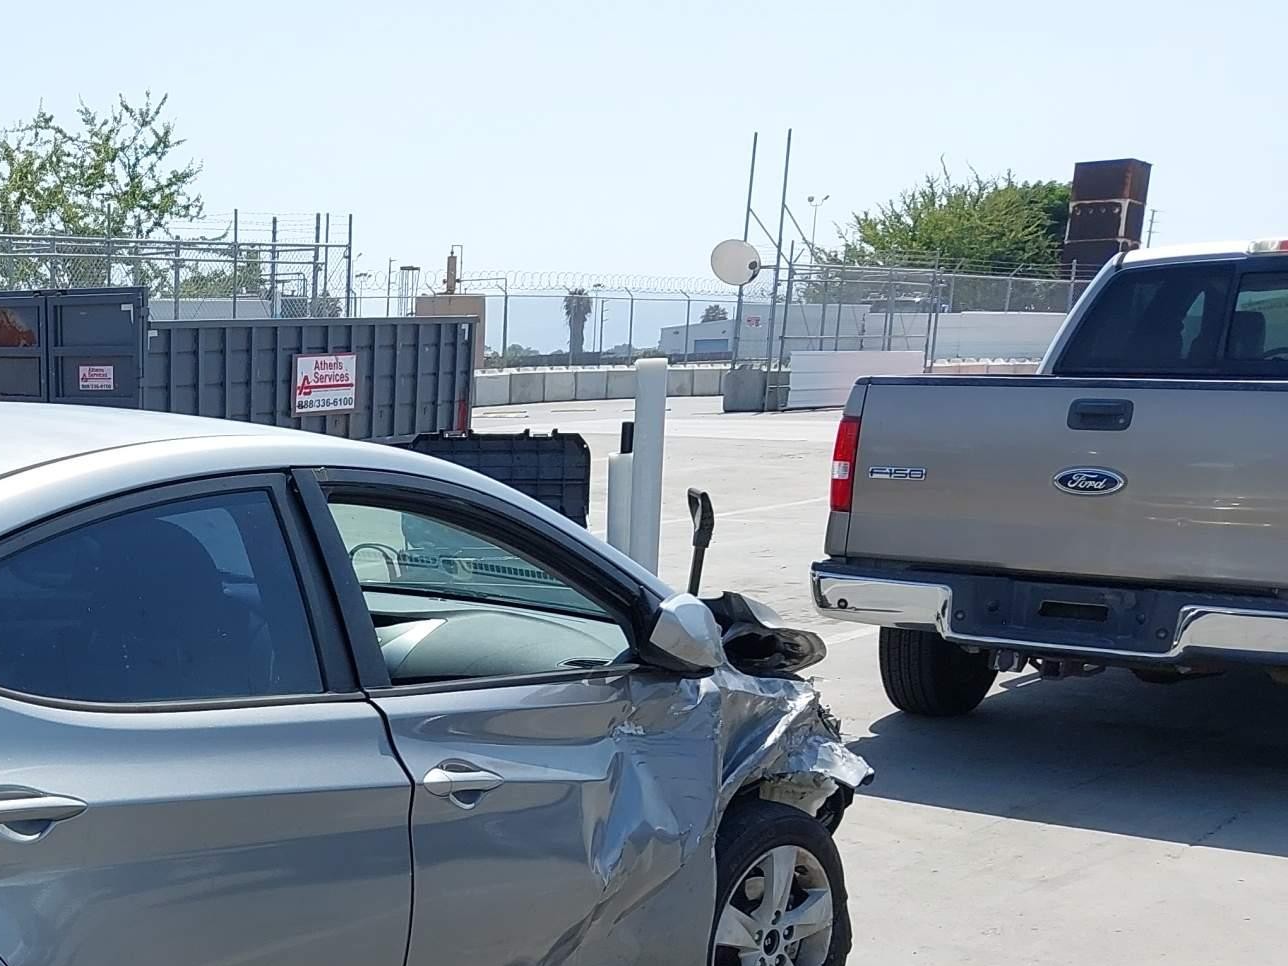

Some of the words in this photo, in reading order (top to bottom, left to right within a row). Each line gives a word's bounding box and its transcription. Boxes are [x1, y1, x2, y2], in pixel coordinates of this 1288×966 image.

[314, 360, 344, 371] Athens
[313, 371, 350, 384] Services
[297, 396, 354, 410] 888/336-6100
[1067, 473, 1107, 489] Ford
